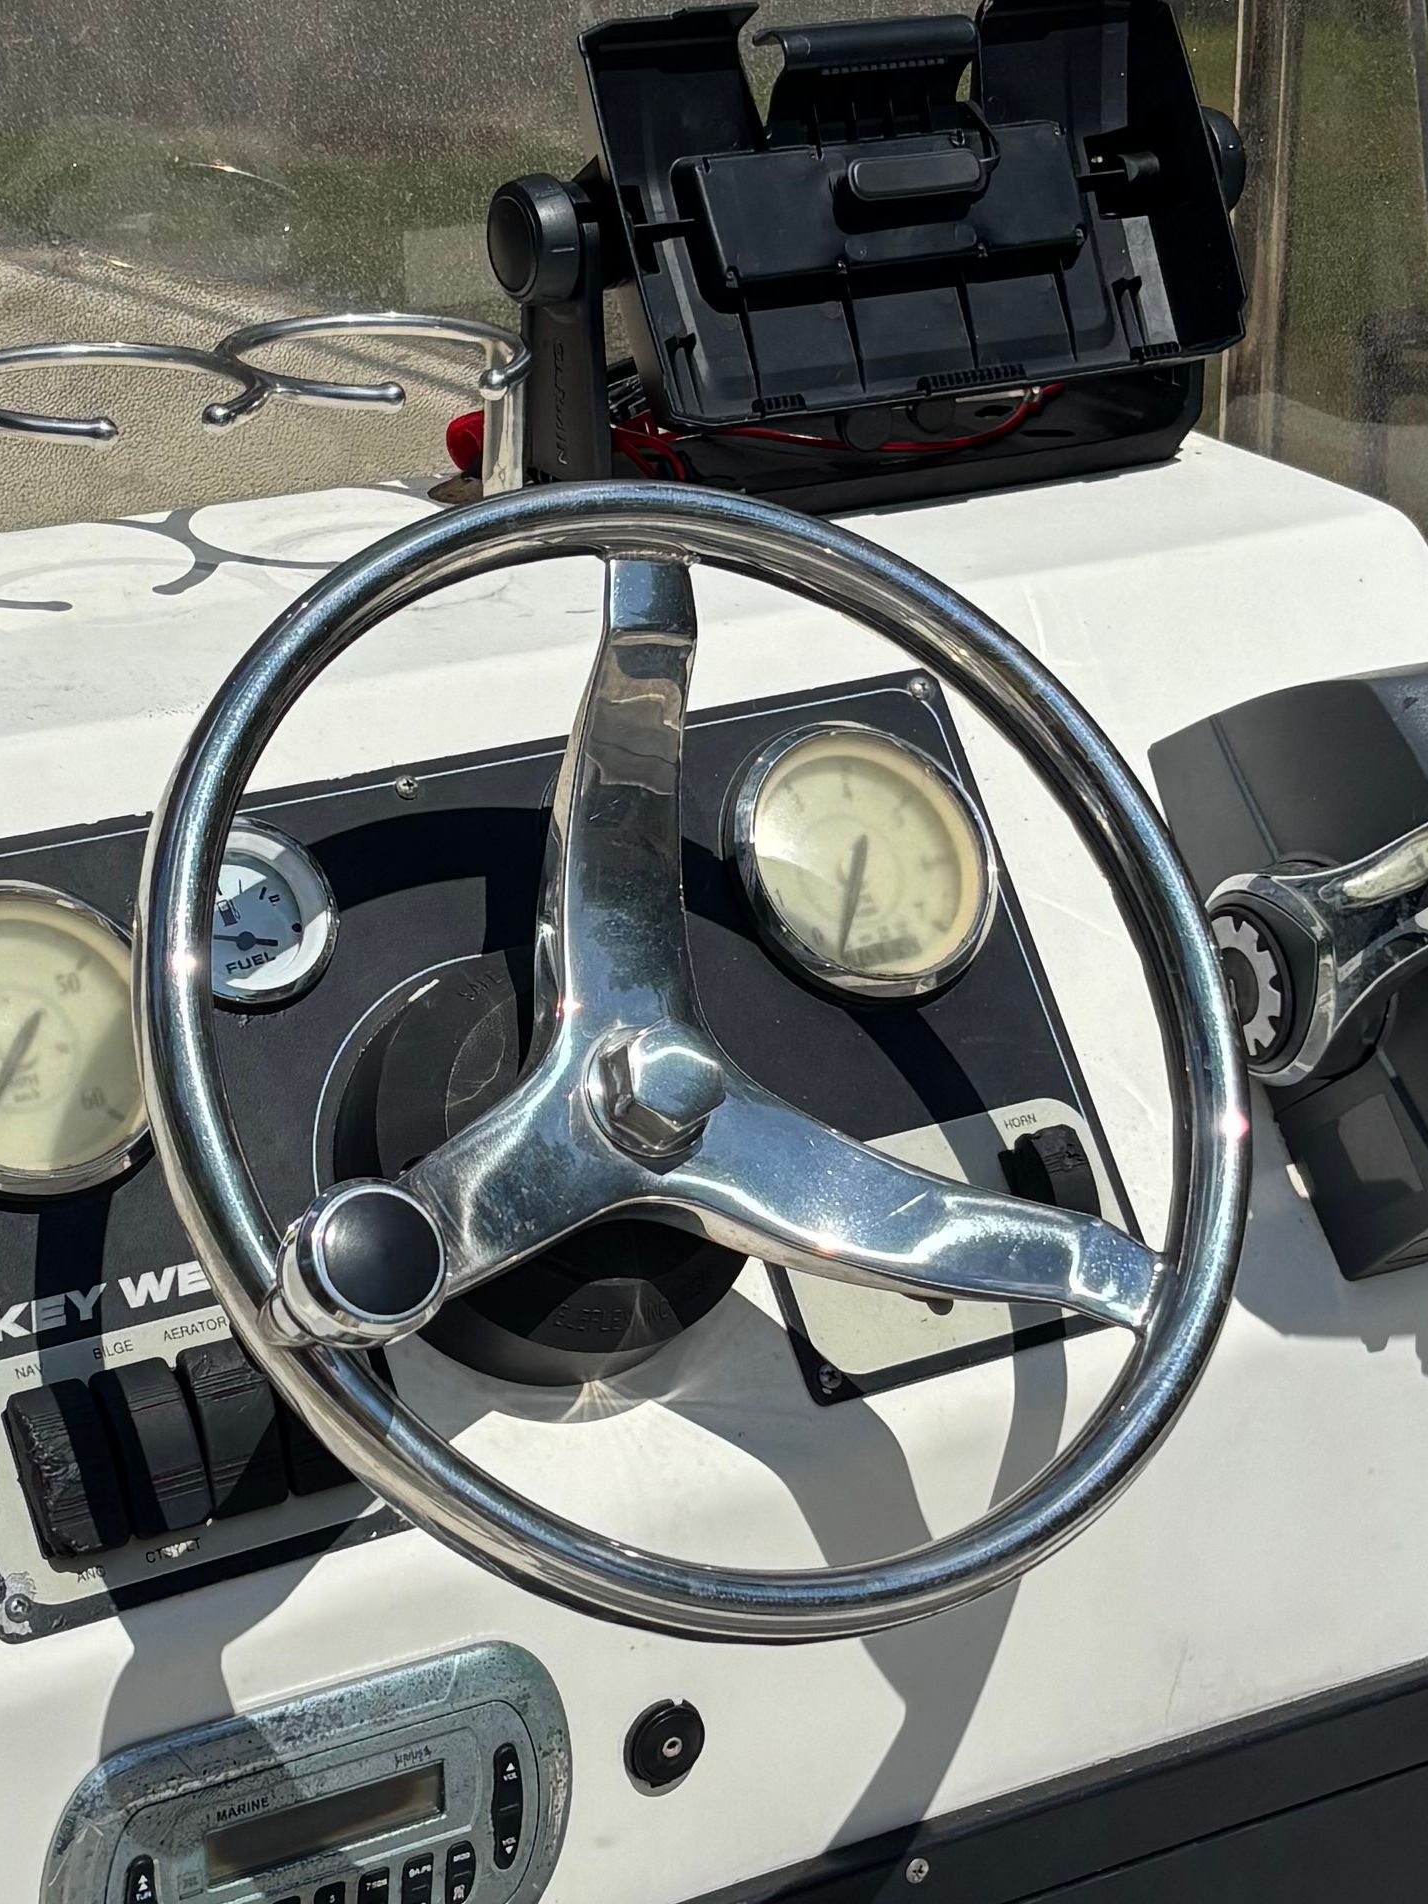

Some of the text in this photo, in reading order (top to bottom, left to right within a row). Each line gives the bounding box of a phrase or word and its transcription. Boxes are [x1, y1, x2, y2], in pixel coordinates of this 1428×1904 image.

[225, 952, 276, 975] FUEL
[55, 972, 81, 995] 50
[80, 1085, 107, 1110] 60
[118, 1260, 213, 1309] WE
[14, 1315, 228, 1381] NAV BILGE AERATOR
[216, 1796, 270, 1822] MARINE
